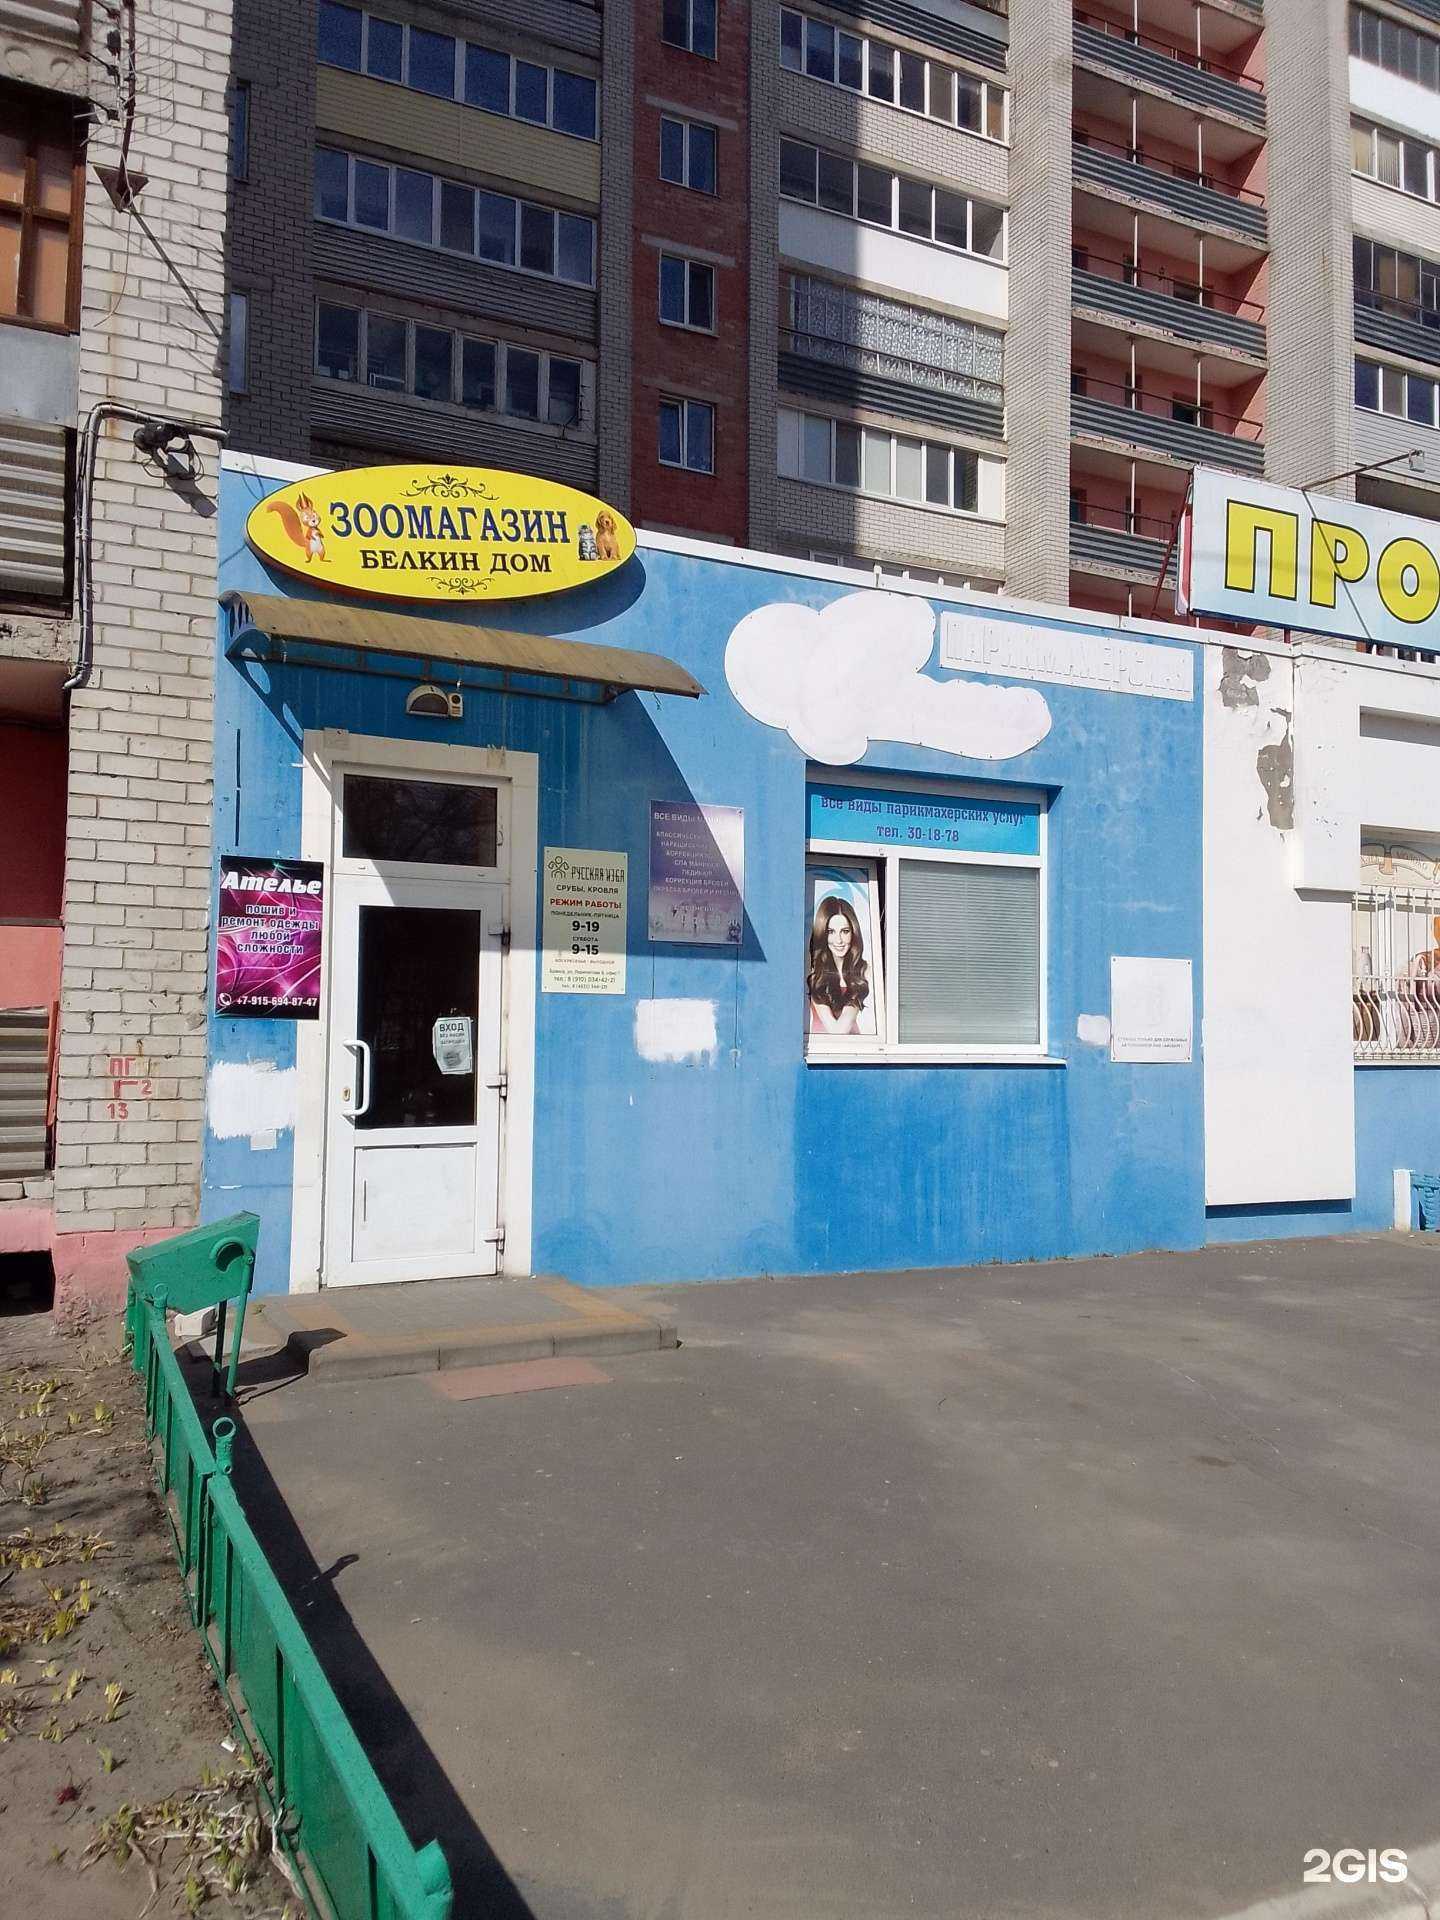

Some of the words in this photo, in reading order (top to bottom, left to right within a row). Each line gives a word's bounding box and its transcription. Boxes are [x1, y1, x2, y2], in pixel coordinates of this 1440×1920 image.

[329, 502, 571, 543] ЗООМАГАЗИН
[360, 549, 480, 571] БЕЛКИН
[490, 554, 552, 575] ДОМ
[1225, 499, 1440, 624] ПРО
[848, 799, 881, 813] виды
[887, 802, 989, 822] парикмахерских
[992, 811, 1026, 825] услуг
[876, 825, 903, 838] тел.
[908, 826, 959, 841] 30-18-78
[221, 871, 322, 895] Ателье
[588, 886, 619, 894] КРОВЛЯ
[550, 898, 583, 907] РЕЖИМ
[585, 900, 622, 909] РАБОТЫ
[245, 905, 285, 916] пошив
[289, 906, 297, 916] и
[221, 916, 267, 928] ремонт
[270, 919, 319, 931] одежды
[572, 920, 600, 932] 9-19
[251, 929, 290, 941] любой
[237, 943, 304, 955] сложности
[572, 944, 599, 955] 9-15
[236, 996, 318, 1007] +7-915-694-87-47
[440, 1023, 464, 1032] ВХОД
